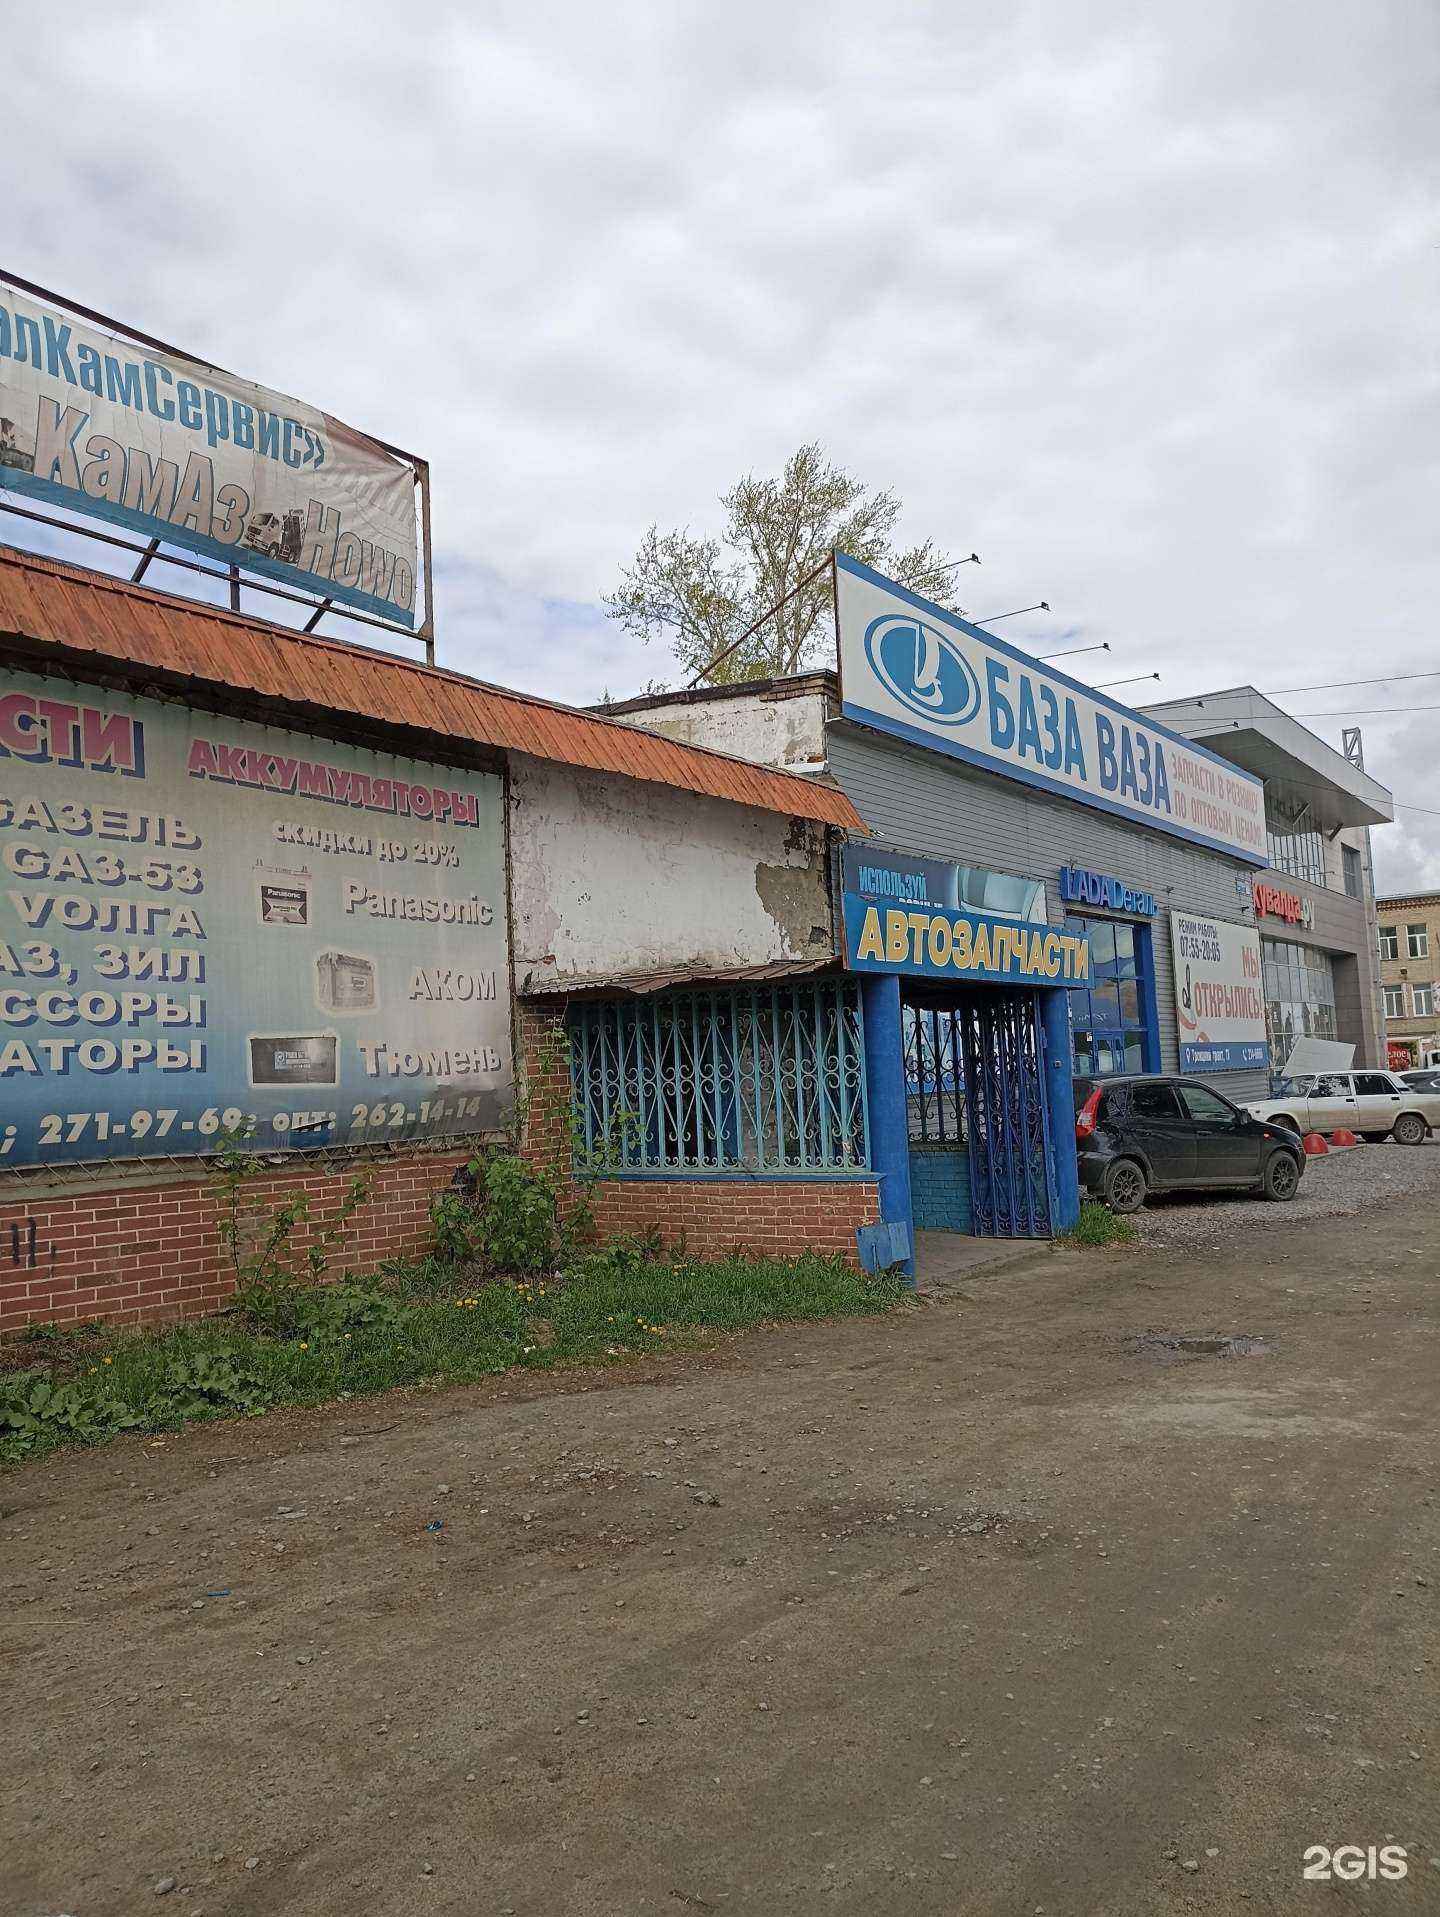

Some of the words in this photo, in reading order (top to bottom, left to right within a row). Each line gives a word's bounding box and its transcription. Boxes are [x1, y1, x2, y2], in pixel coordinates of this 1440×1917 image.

[985, 656, 1088, 783] БАЗА
[1094, 710, 1172, 815] ВАЗА
[188, 738, 480, 829] АККУМУЛЯТОРЫ
[1171, 751, 1216, 797] ЗАПЧАСТИ
[1174, 789, 1187, 819] ПО
[343, 878, 494, 927] Panasonic
[858, 865, 927, 901] ИСПОЛЬЗУЙ
[857, 906, 1089, 980] АВТОЗАПЧАСТИ
[1242, 945, 1260, 979] МЫ
[93, 944, 206, 984] ЗИЛ
[409, 966, 496, 1001] АКОМ
[0, 989, 207, 1028] ССОРЫ
[0, 1038, 207, 1078] АТОРЫ
[357, 1040, 502, 1079] Тюмень
[351, 1096, 481, 1129] 262-14-14
